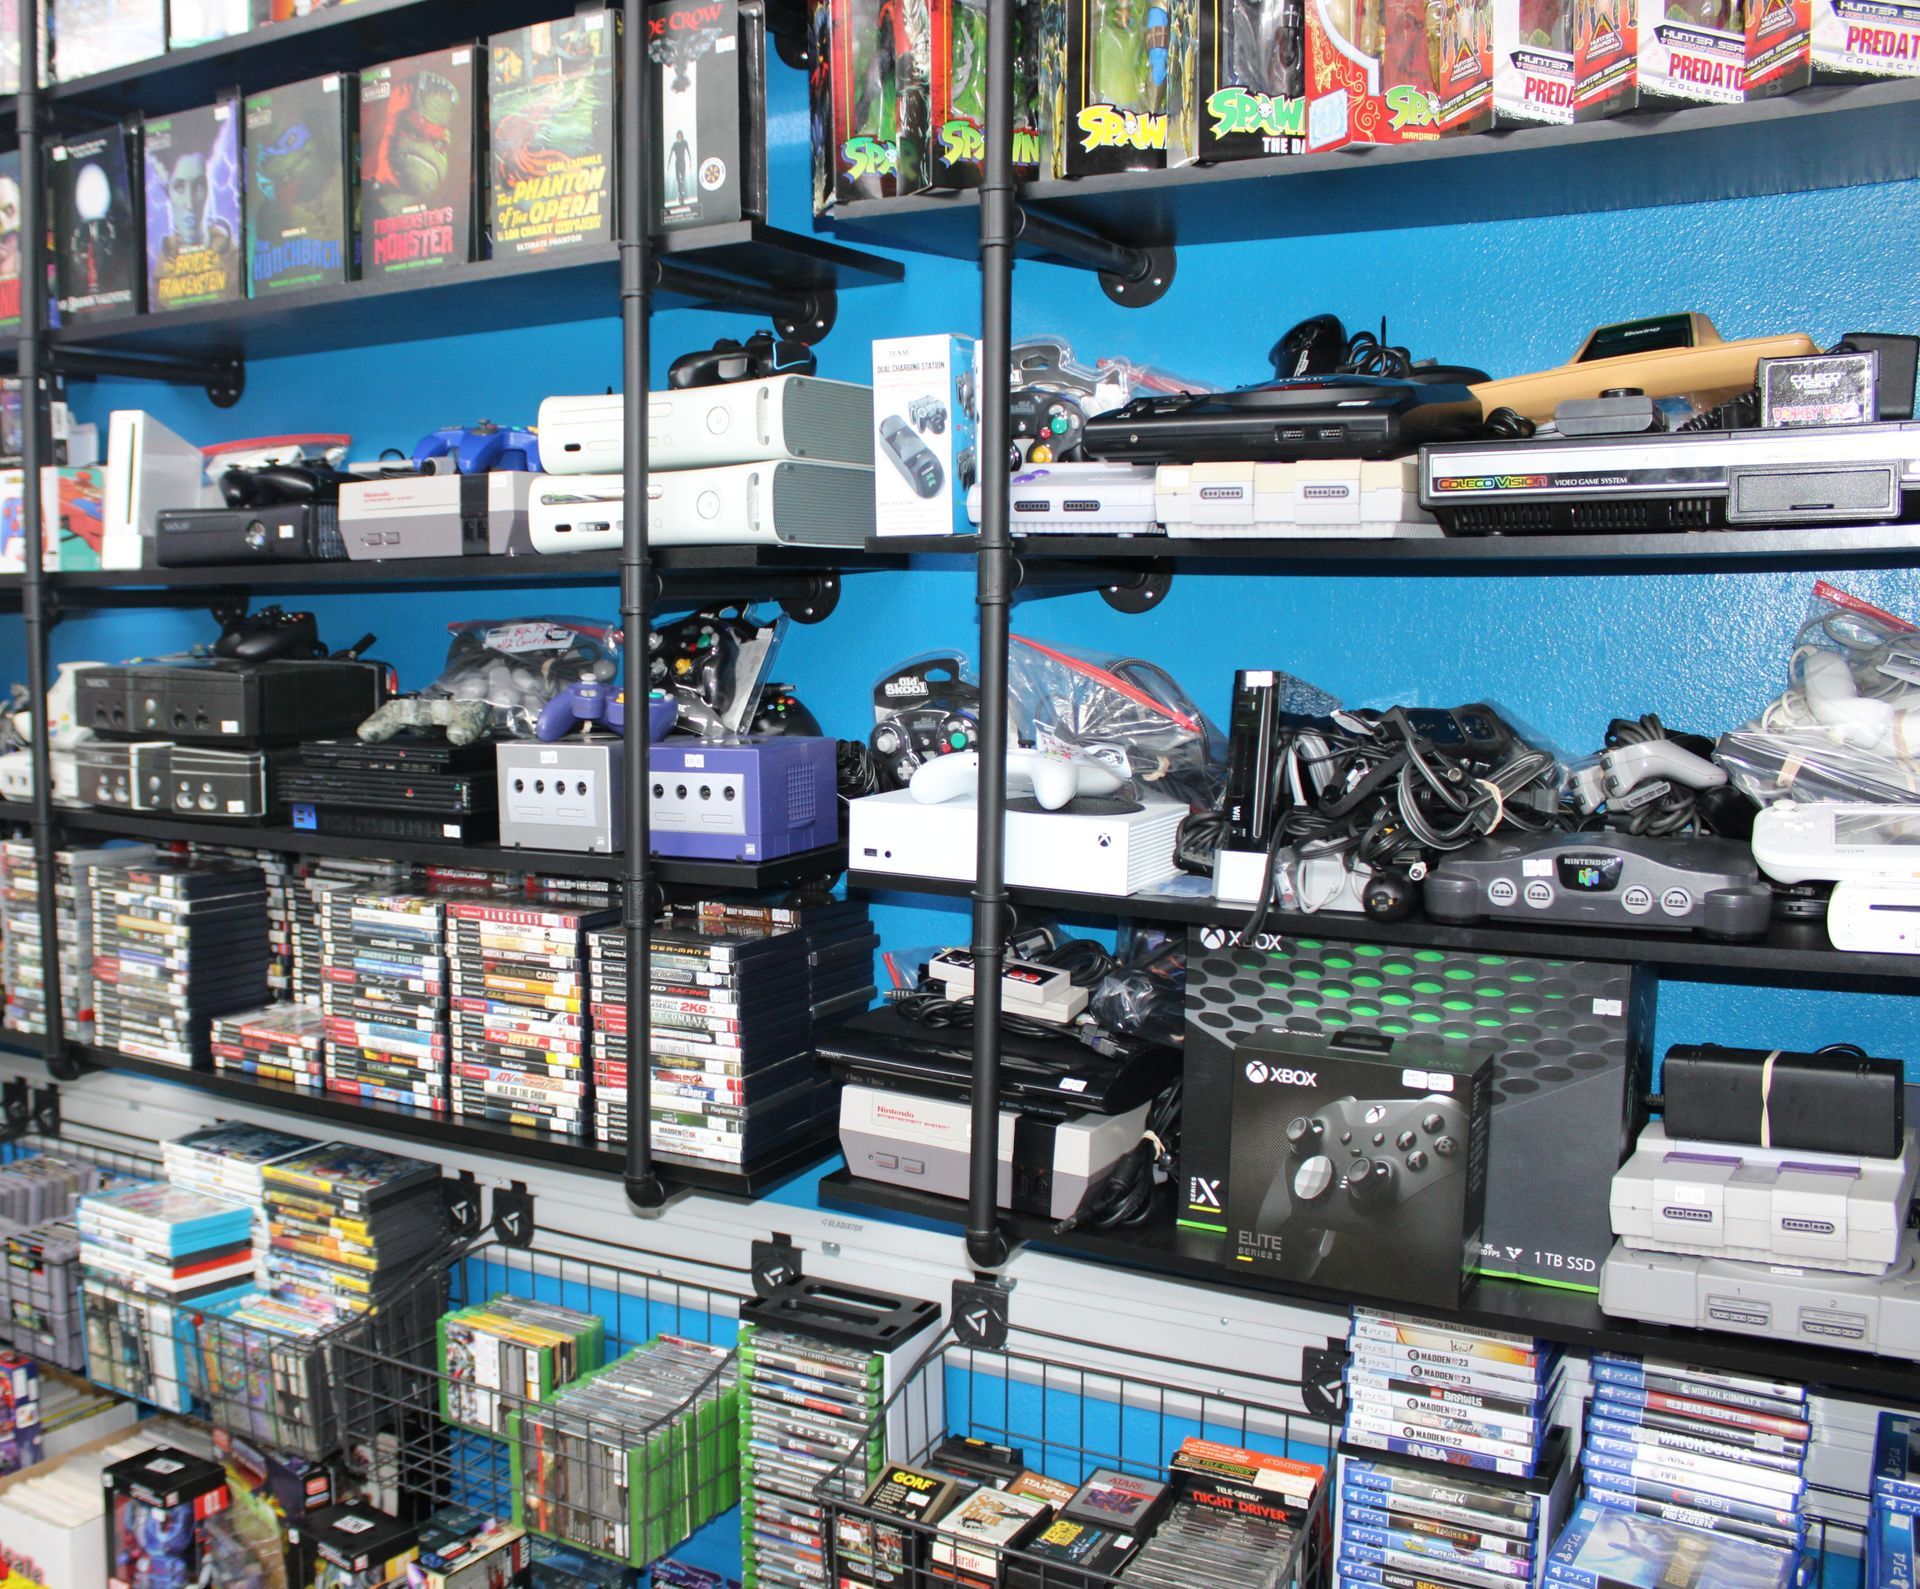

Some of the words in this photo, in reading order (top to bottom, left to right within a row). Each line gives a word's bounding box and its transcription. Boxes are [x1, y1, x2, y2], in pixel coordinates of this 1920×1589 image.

[669, 3, 724, 31] CROW
[1840, 1, 1898, 17] HUNTER
[1663, 29, 1713, 46] HUNTER
[1718, 41, 1744, 53] SERI
[1846, 26, 1920, 60] PREDAT
[1519, 55, 1569, 71] HUNTER
[1669, 53, 1744, 91] PREDATO
[1524, 77, 1575, 107] PREDA
[1669, 80, 1742, 101] COLLECTIO
[1206, 85, 1305, 140] SPAW
[1076, 103, 1167, 153] SPAW
[1262, 137, 1284, 153] THE
[513, 166, 606, 204] PHANTOM
[374, 225, 453, 266] MONSTER
[892, 362, 920, 374] CHARGING
[921, 360, 945, 372] STATION
[1790, 372, 1841, 383] COLECO
[1555, 478, 1578, 487] VIDEO
[1578, 477, 1600, 486] GAME
[1600, 477, 1628, 485] SYSTEM
[885, 682, 929, 697] Skool
[1232, 805, 1241, 821] Wii
[1228, 930, 1282, 951] XOX
[536, 971, 560, 983] CASIN
[667, 986, 710, 997] RACING
[651, 1002, 678, 1011] ASEBALL
[680, 1001, 708, 1015] 2K6
[374, 1015, 409, 1026] FACTION
[1270, 1067, 1317, 1088] XBOX
[680, 1087, 709, 1099] HEROES
[877, 1105, 915, 1119] Nintendo
[659, 1127, 682, 1137] MADDEN
[828, 1219, 864, 1233] GLADIATOR
[1238, 1230, 1282, 1251] ELITE
[1238, 1246, 1273, 1260] SERIES
[1276, 1253, 1282, 1261] 2
[1488, 1250, 1500, 1258] FPS
[1534, 1251, 1541, 1264] 1
[1545, 1252, 1563, 1268] TB
[1566, 1256, 1596, 1272] SSD
[1830, 1299, 1837, 1308] 2
[1412, 1317, 1442, 1330] DRAGON
[1444, 1322, 1463, 1333] BALL
[807, 1352, 826, 1361] CREED
[1420, 1352, 1451, 1365] MADDEN
[1458, 1358, 1469, 1368] 23
[1424, 1368, 1454, 1382] MADDEN
[1460, 1375, 1471, 1385] 23
[1614, 1372, 1639, 1382] PS4
[1443, 1391, 1483, 1407] BRAWLS
[1691, 1385, 1722, 1398] MORTAL
[1723, 1391, 1752, 1406] KOMBAT
[1753, 1398, 1762, 1408] X
[1420, 1402, 1450, 1415] MADDEN
[1457, 1408, 1468, 1418] 23
[1612, 1407, 1636, 1418] PS4
[1617, 1391, 1641, 1401] PS4
[1665, 1398, 1682, 1409] RED
[1682, 1402, 1703, 1414] DEAD
[1703, 1406, 1752, 1425] REDEMPTION
[1416, 1430, 1446, 1444] MADDEN
[1452, 1437, 1463, 1446] 22
[1200, 1460, 1251, 1475] TELE-GAMES
[1602, 1459, 1627, 1469] PS4
[1661, 1471, 1677, 1481] FIFA
[892, 1472, 933, 1491] GORF
[1108, 1476, 1143, 1491] ATARI
[1606, 1475, 1631, 1486] PS4
[1022, 1478, 1074, 1500] STAMPED
[1216, 1485, 1261, 1502] TELE-GAMES
[1366, 1478, 1388, 1488] PS4
[1431, 1487, 1456, 1503] Fallout
[1457, 1493, 1465, 1504] 4
[1192, 1490, 1234, 1509] NIGHT
[1238, 1502, 1288, 1521] DRIVER
[1360, 1494, 1383, 1504] PS4
[1605, 1495, 1630, 1507] PS4
[1361, 1513, 1384, 1523] PS4
[1361, 1532, 1383, 1543] PS4
[1359, 1550, 1381, 1560] PS4
[1893, 1552, 1907, 1576] PS4
[1354, 1568, 1377, 1579] PS4
